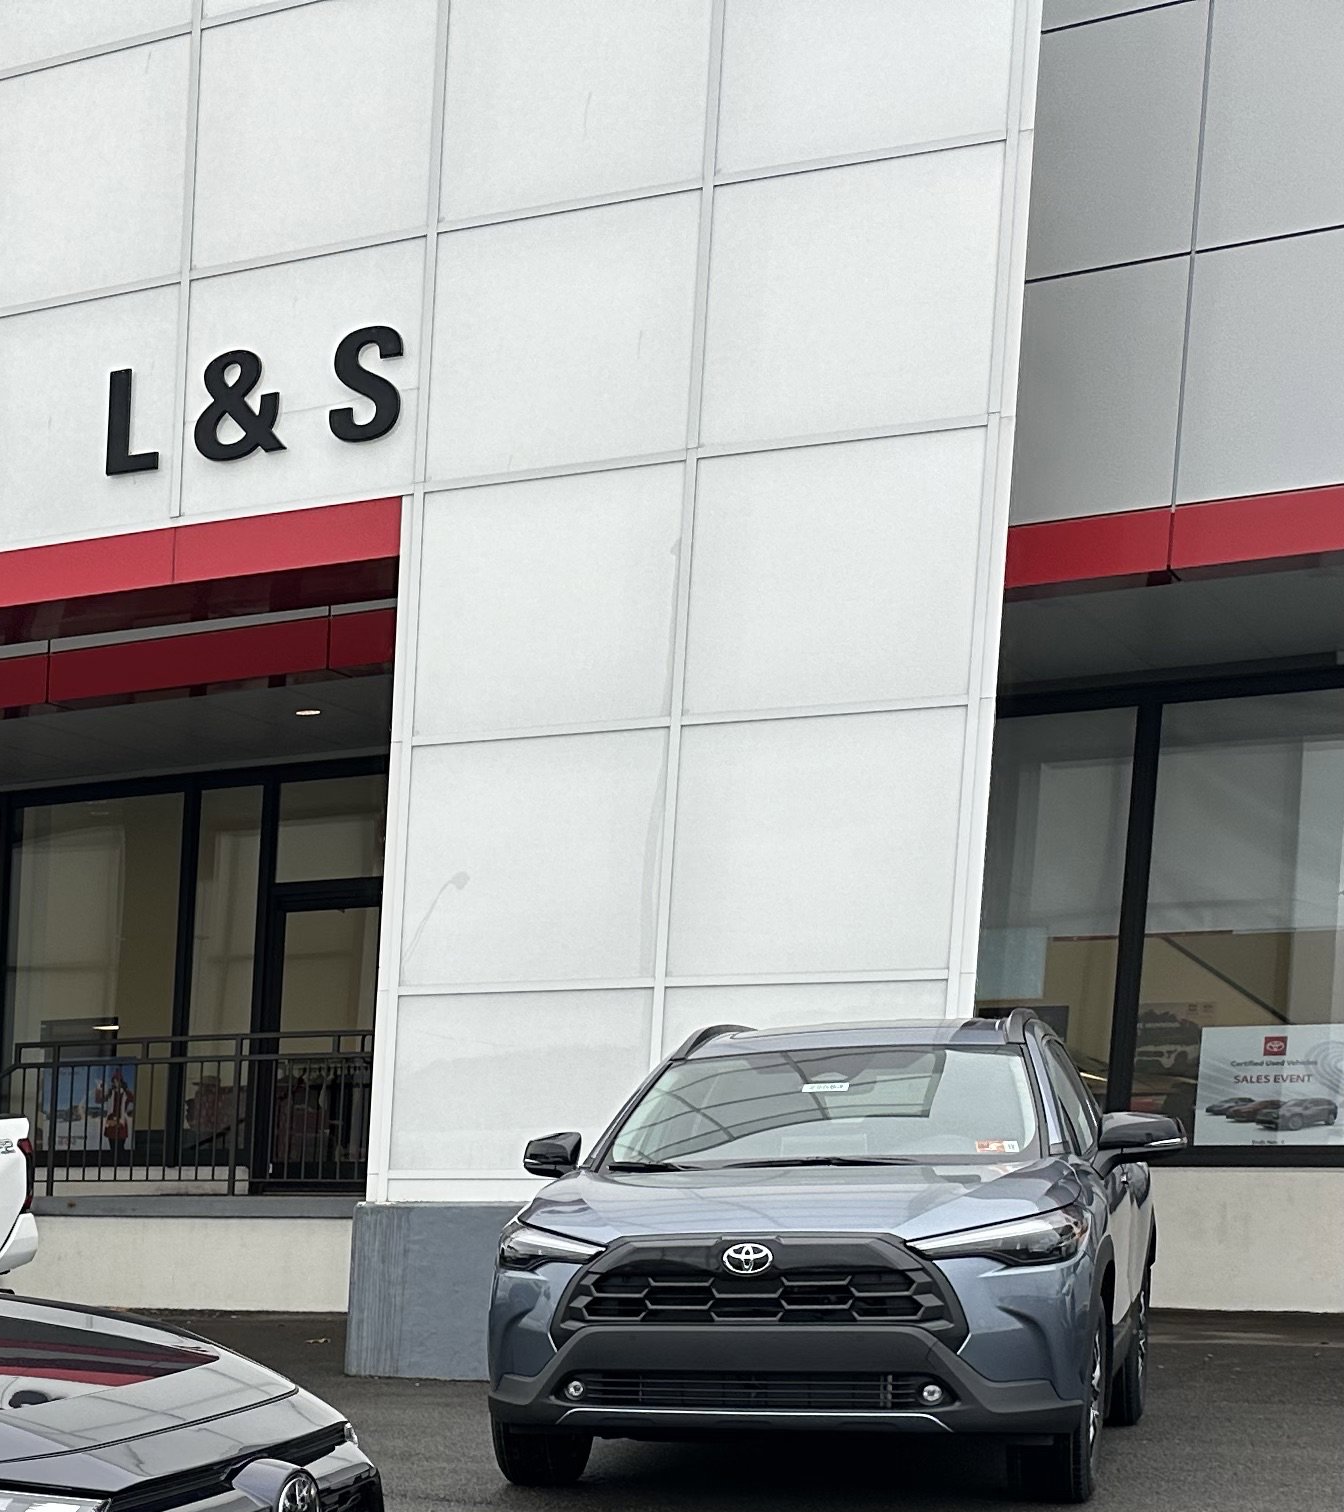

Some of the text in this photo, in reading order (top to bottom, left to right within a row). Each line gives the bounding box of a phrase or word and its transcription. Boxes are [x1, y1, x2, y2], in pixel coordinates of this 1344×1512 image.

[106, 325, 404, 476] L & S
[1233, 1074, 1313, 1084] SALES EVENT
